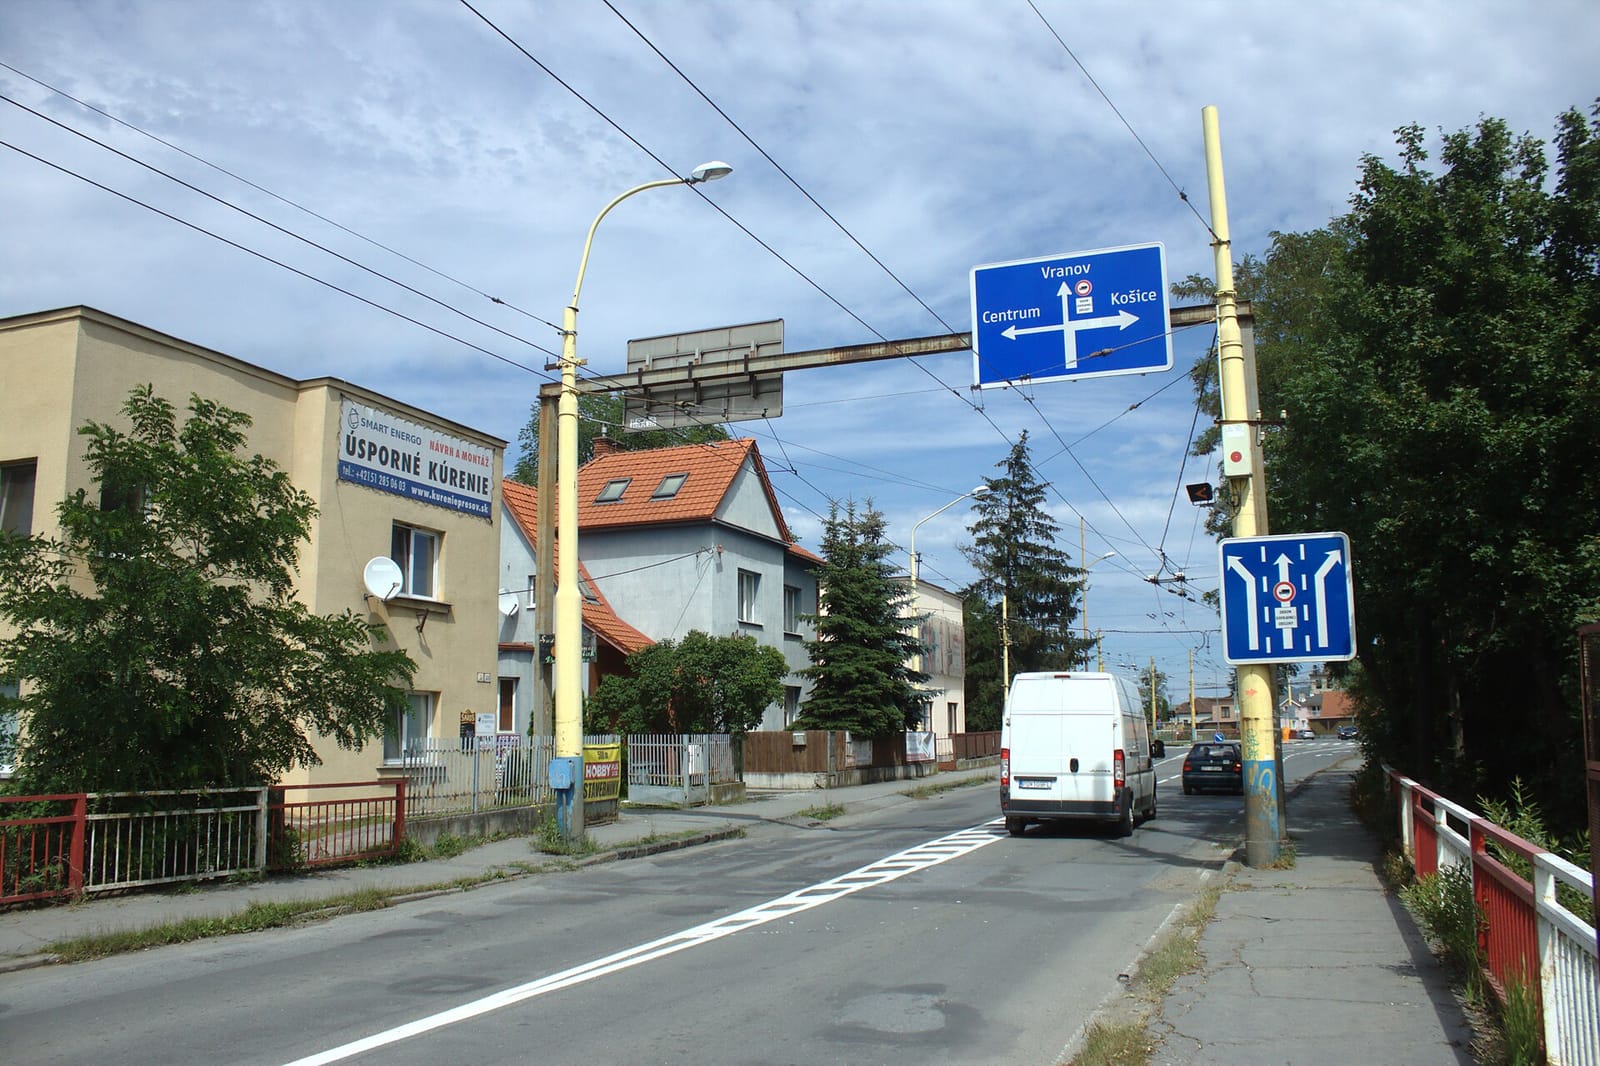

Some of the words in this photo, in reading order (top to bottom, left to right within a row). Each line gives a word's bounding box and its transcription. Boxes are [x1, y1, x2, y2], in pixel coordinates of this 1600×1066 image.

[1041, 263, 1091, 279] Vranov
[1110, 290, 1157, 306] Košice
[982, 306, 1041, 324] Centrum
[361, 418, 389, 434] SMART
[390, 428, 422, 445] ENERGO
[346, 430, 421, 476] ÚSPORNÉ
[429, 460, 489, 495] KÚRENIE
[430, 439, 454, 456] NÁVRH
[456, 448, 461, 458] A
[462, 450, 489, 467] MONTÁŽ
[411, 486, 489, 513] www.kureniepresov.sk
[585, 763, 611, 778] HOBBY
